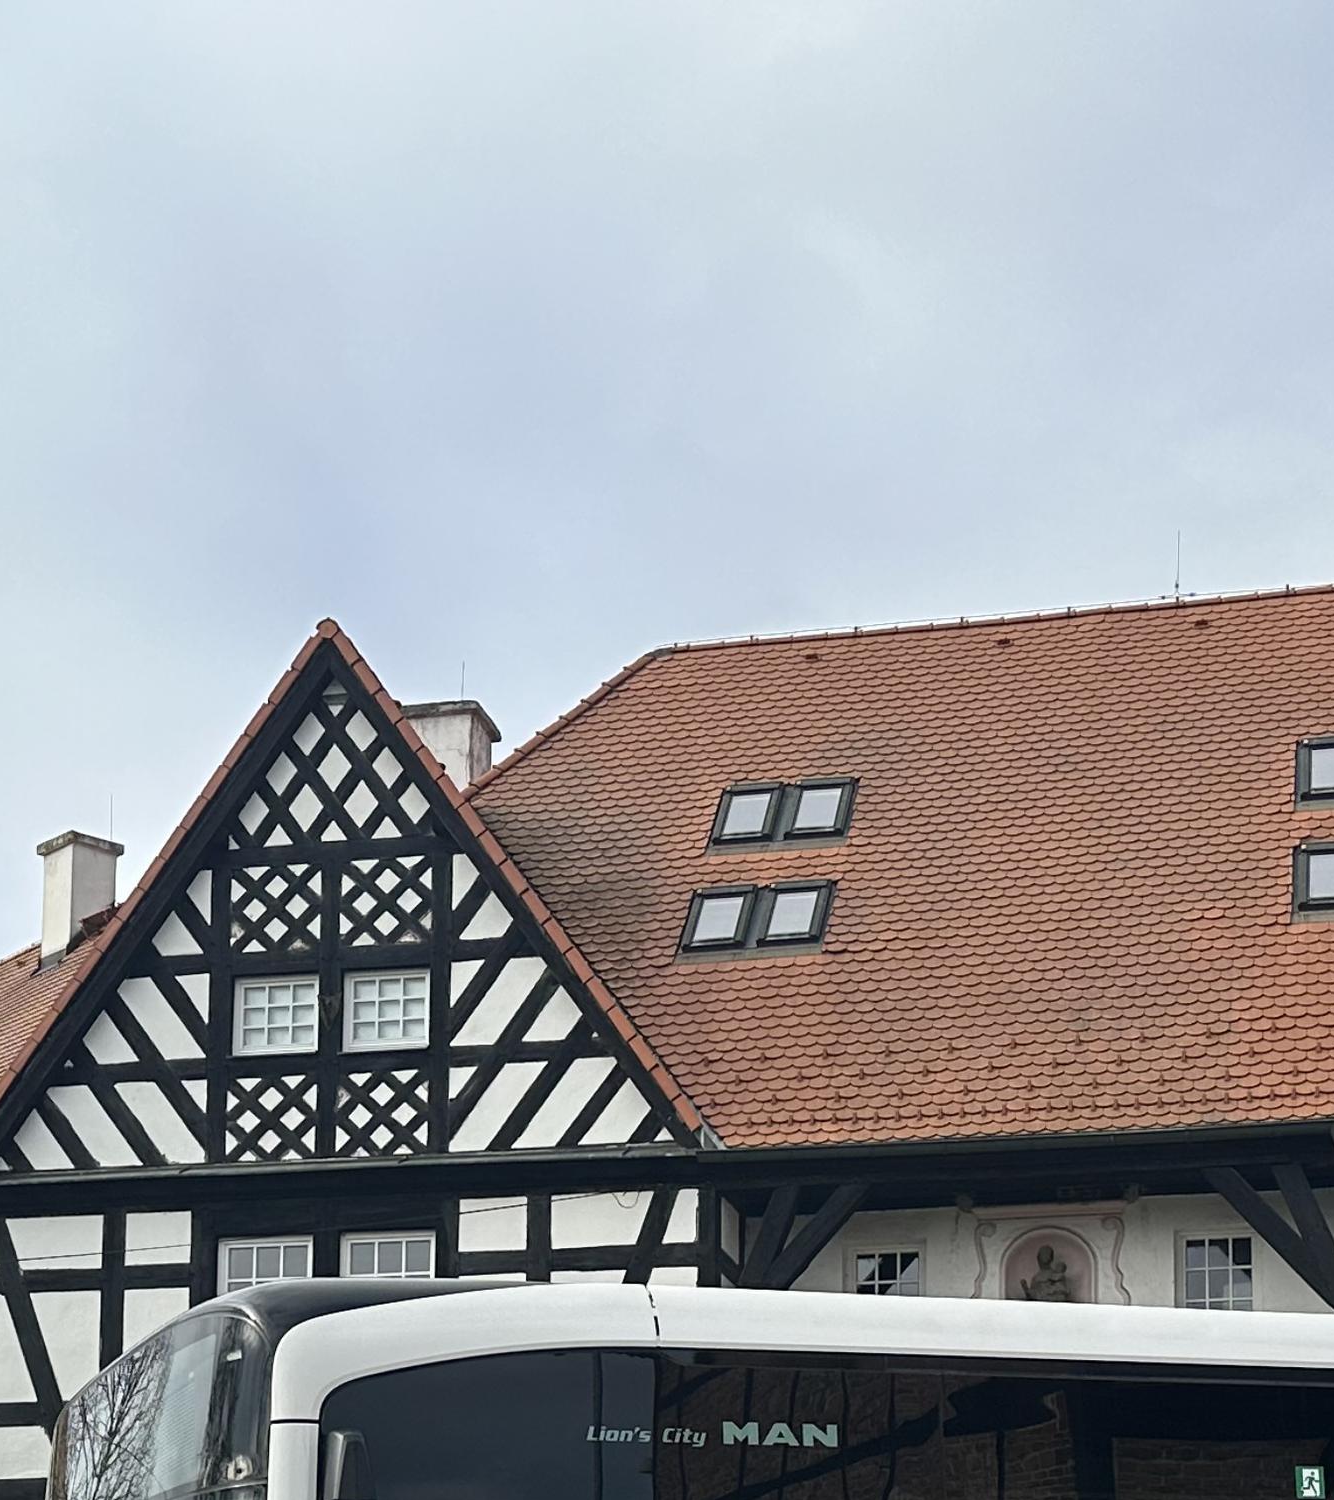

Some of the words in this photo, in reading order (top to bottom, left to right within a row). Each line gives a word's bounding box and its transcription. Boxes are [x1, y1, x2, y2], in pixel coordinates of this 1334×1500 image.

[586, 1425, 652, 1443] Lion's
[662, 1427, 707, 1448] City
[722, 1421, 839, 1448] MAN
